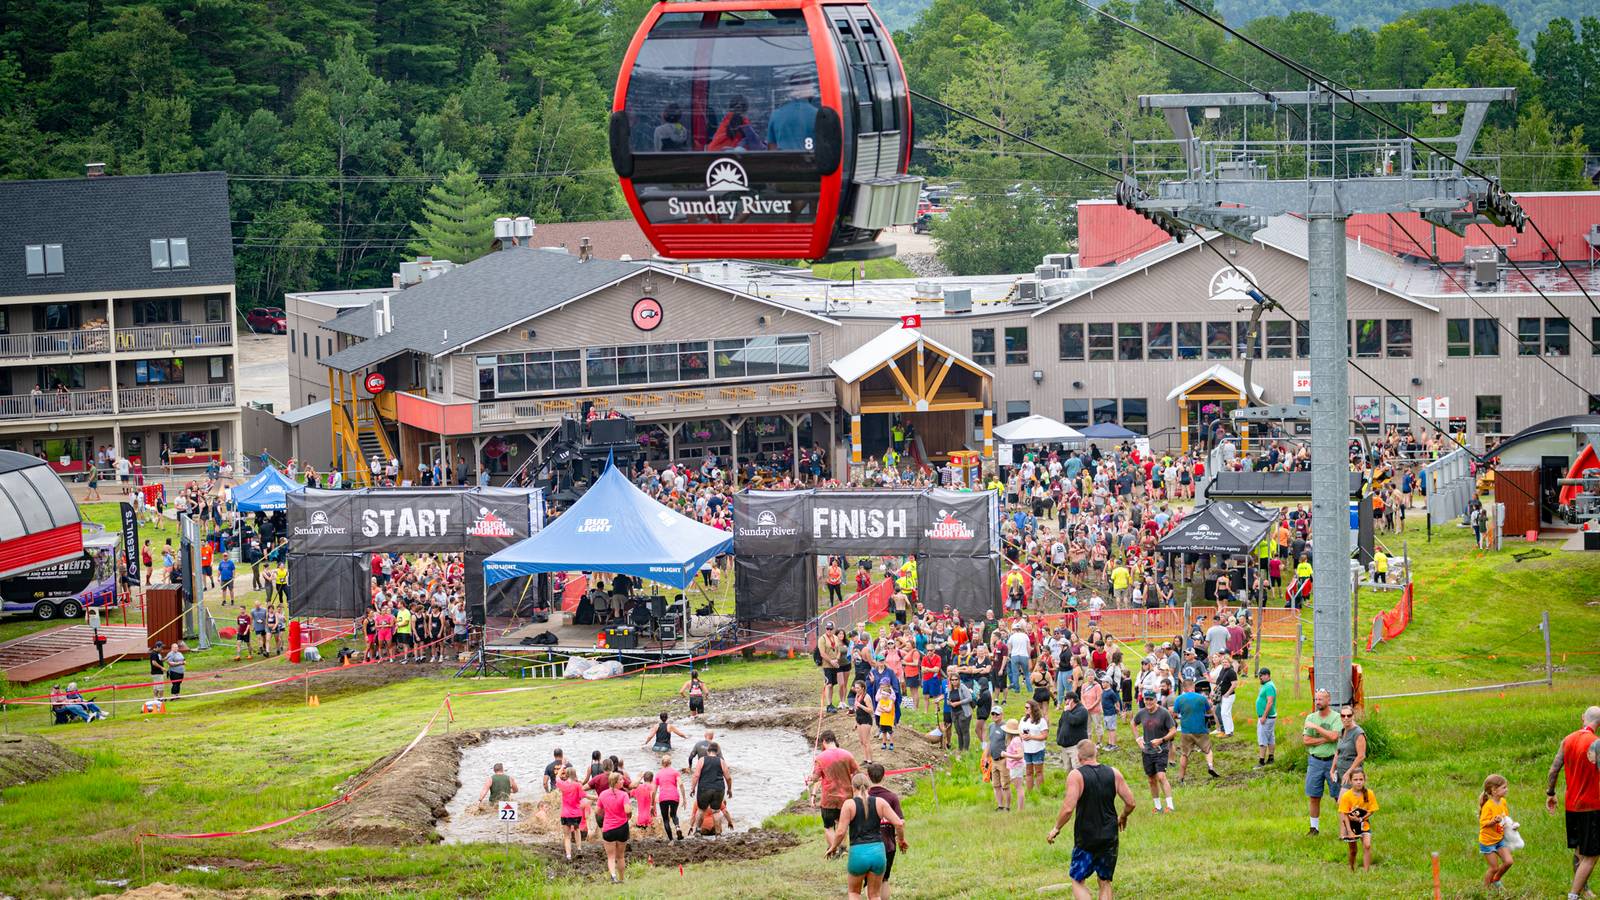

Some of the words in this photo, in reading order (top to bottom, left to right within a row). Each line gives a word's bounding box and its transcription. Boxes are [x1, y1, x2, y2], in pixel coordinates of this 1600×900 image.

[804, 137, 814, 150] 8
[668, 194, 737, 220] Sunday
[740, 194, 792, 214] River
[362, 507, 451, 538] START
[473, 520, 507, 529] TOUGH
[584, 518, 610, 526] BUD
[813, 507, 907, 539] FINISH
[932, 522, 967, 531] TOUGH
[294, 525, 323, 537] Sunday
[466, 526, 514, 536] MOUNTAIN
[577, 525, 613, 533] LIGHT
[739, 527, 771, 539] Sunday
[925, 528, 975, 538] MOUNTAIN
[125, 510, 136, 560] RESULTS
[58, 560, 92, 571] EVENTS
[500, 809, 516, 820] 22
